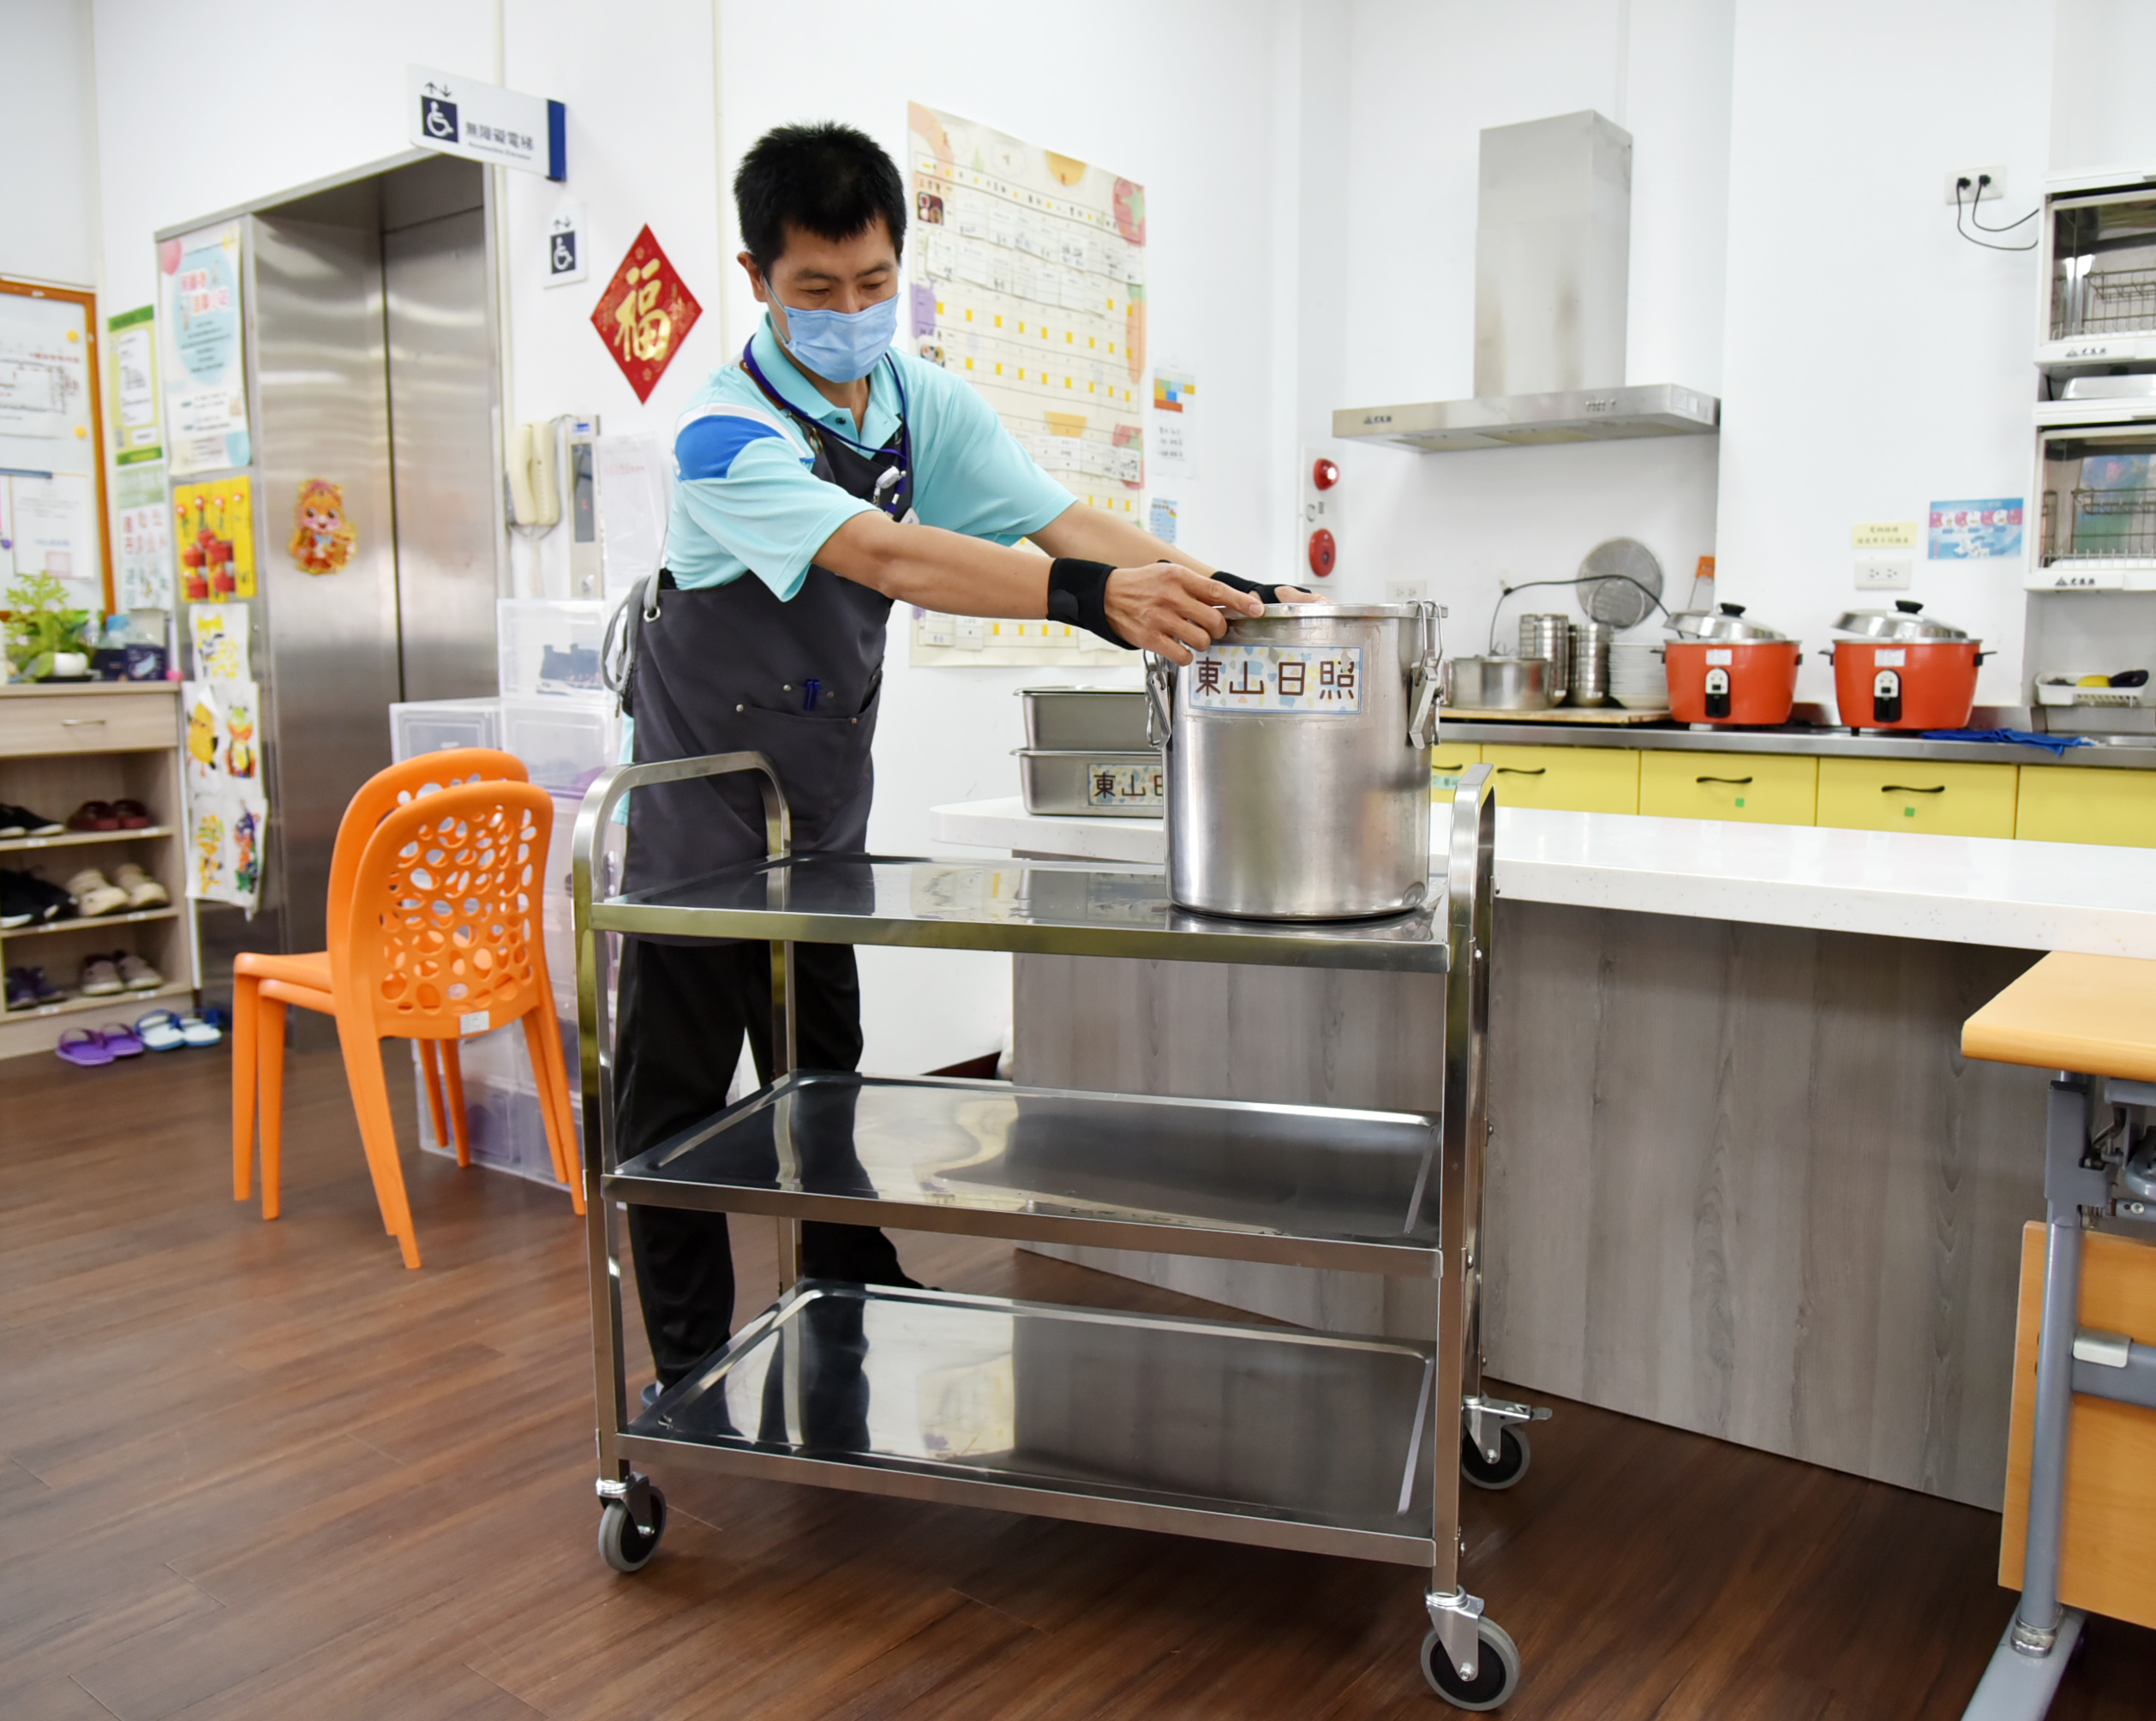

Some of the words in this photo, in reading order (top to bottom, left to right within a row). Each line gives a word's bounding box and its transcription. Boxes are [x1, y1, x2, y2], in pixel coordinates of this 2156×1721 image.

[464, 122, 533, 151] 無障礙電梯
[614, 258, 671, 362] 福
[1195, 657, 1355, 699] 東山日照
